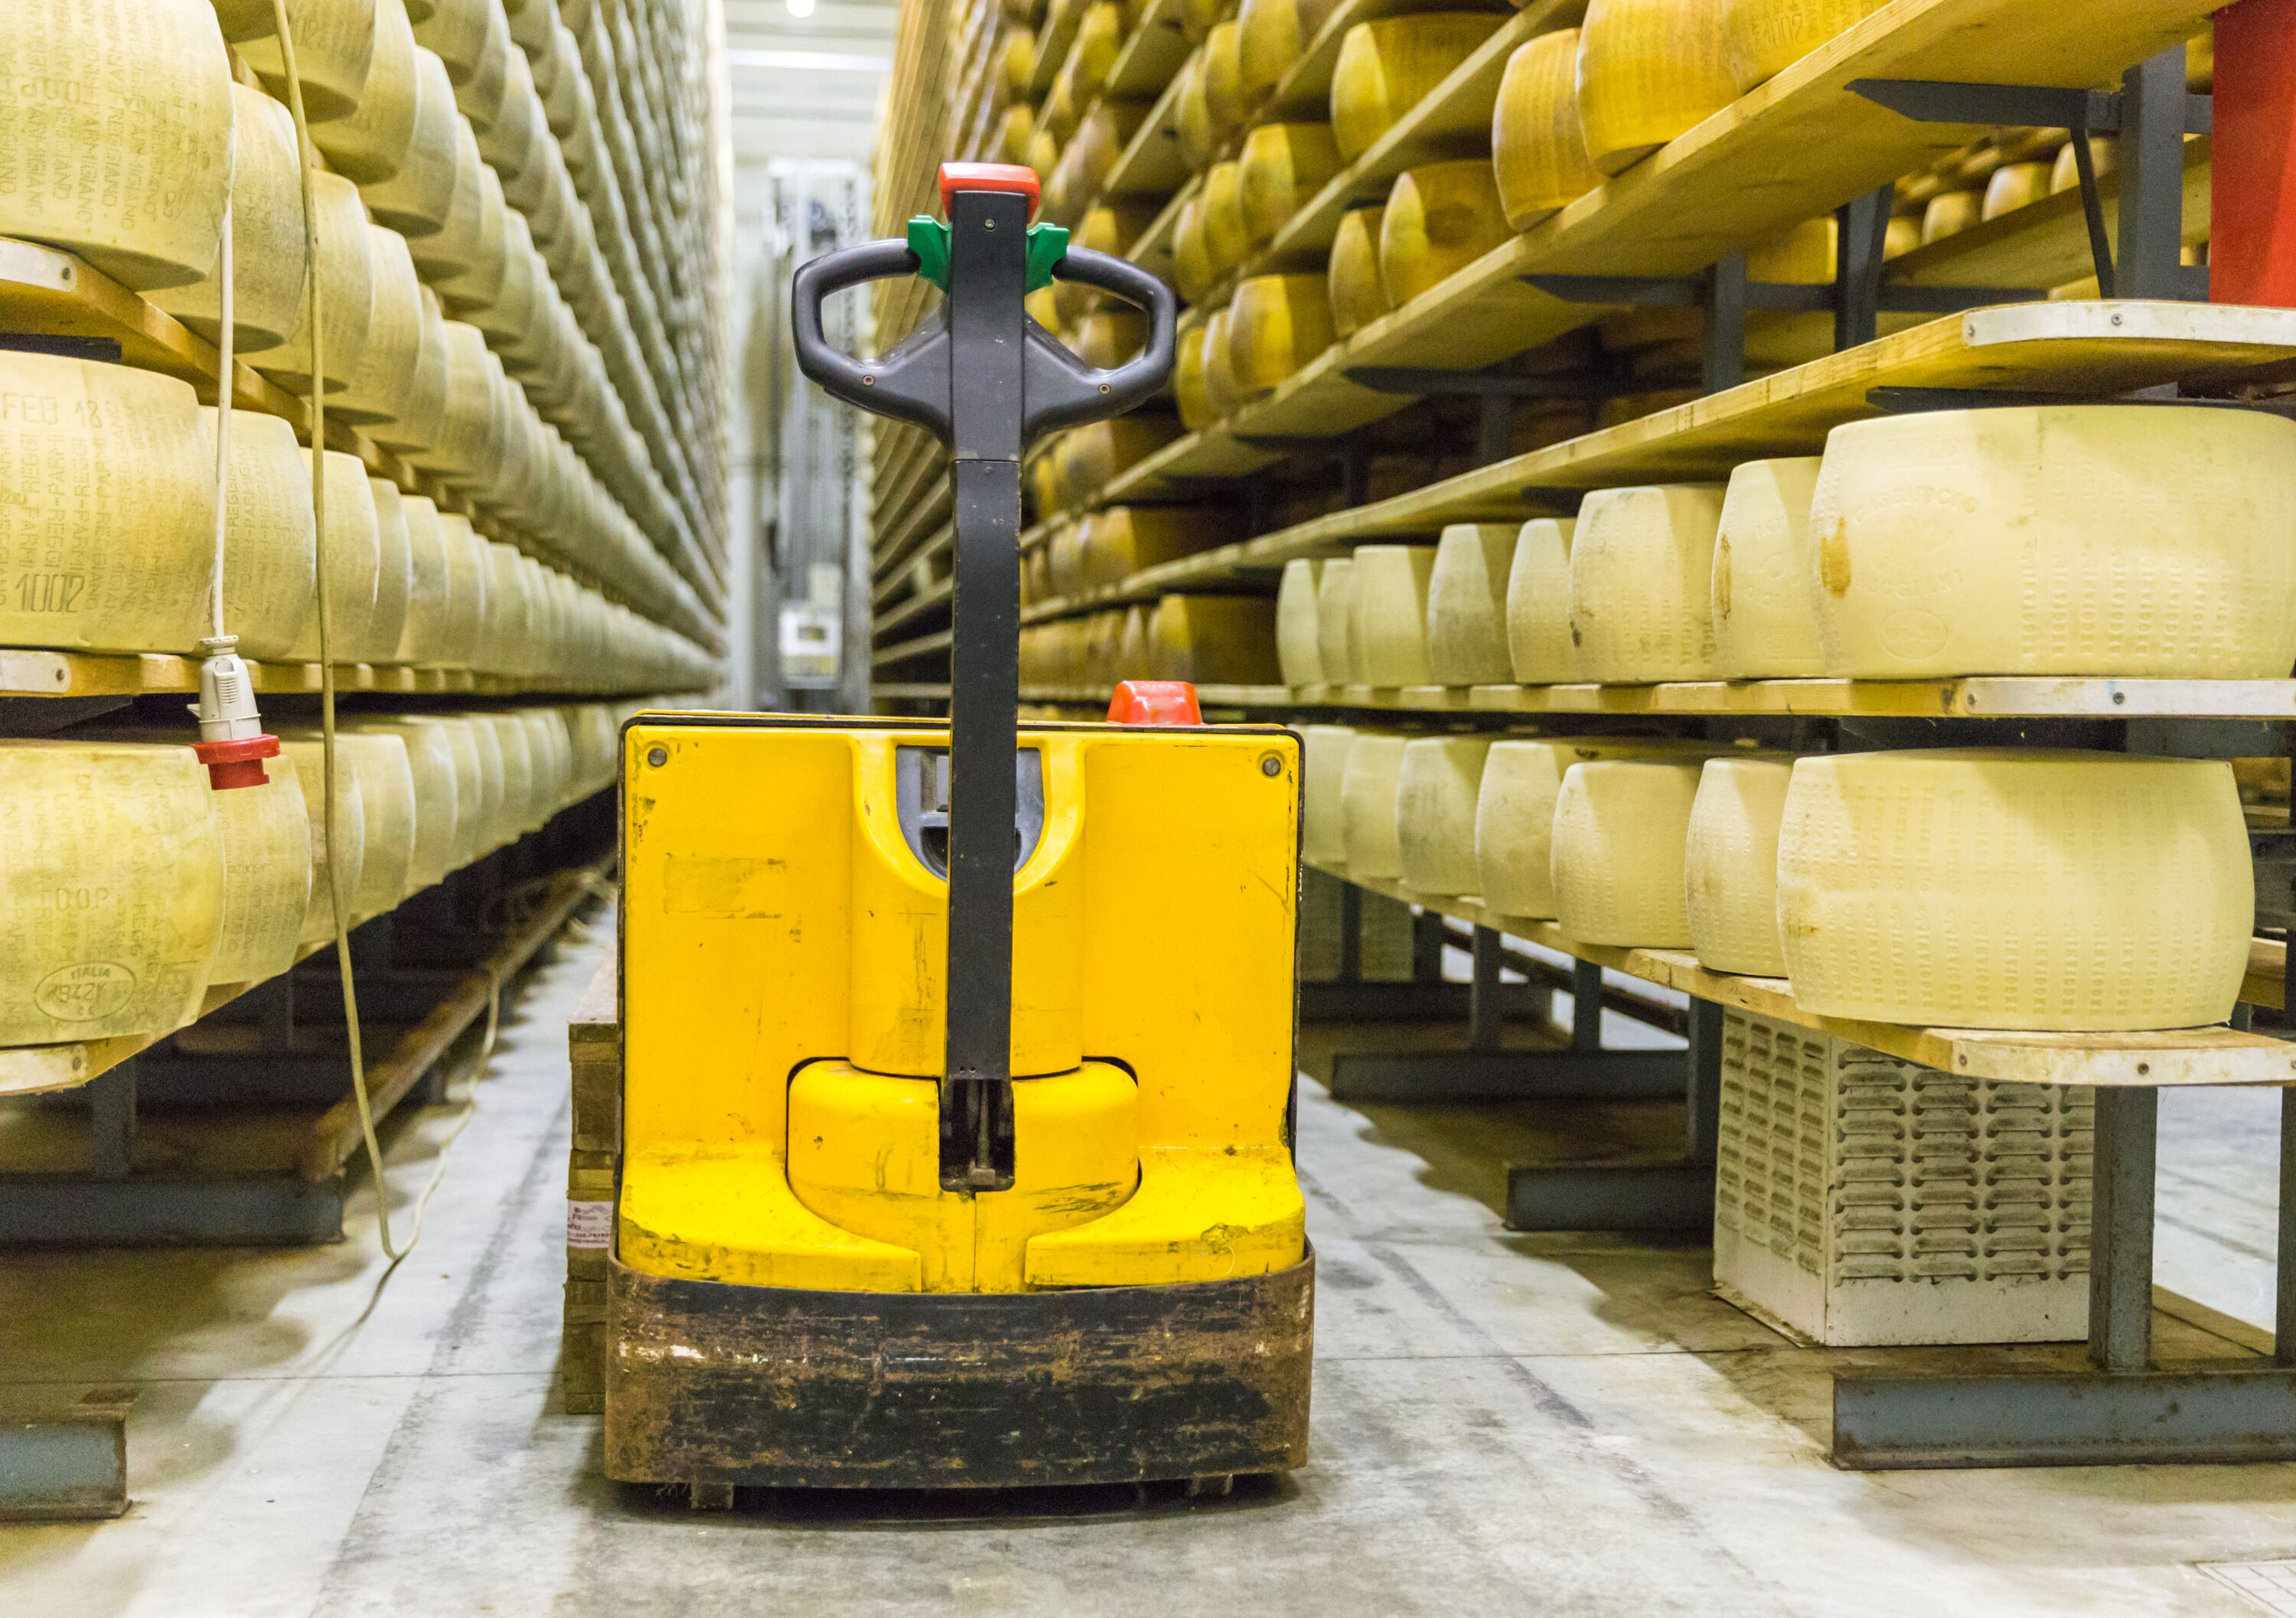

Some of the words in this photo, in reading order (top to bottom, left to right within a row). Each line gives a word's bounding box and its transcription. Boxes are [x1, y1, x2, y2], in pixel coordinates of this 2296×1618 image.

[2, 393, 58, 425] FEB
[15, 572, 86, 613] 1002
[55, 886, 109, 912] DOP
[70, 966, 111, 980] ITALIA
